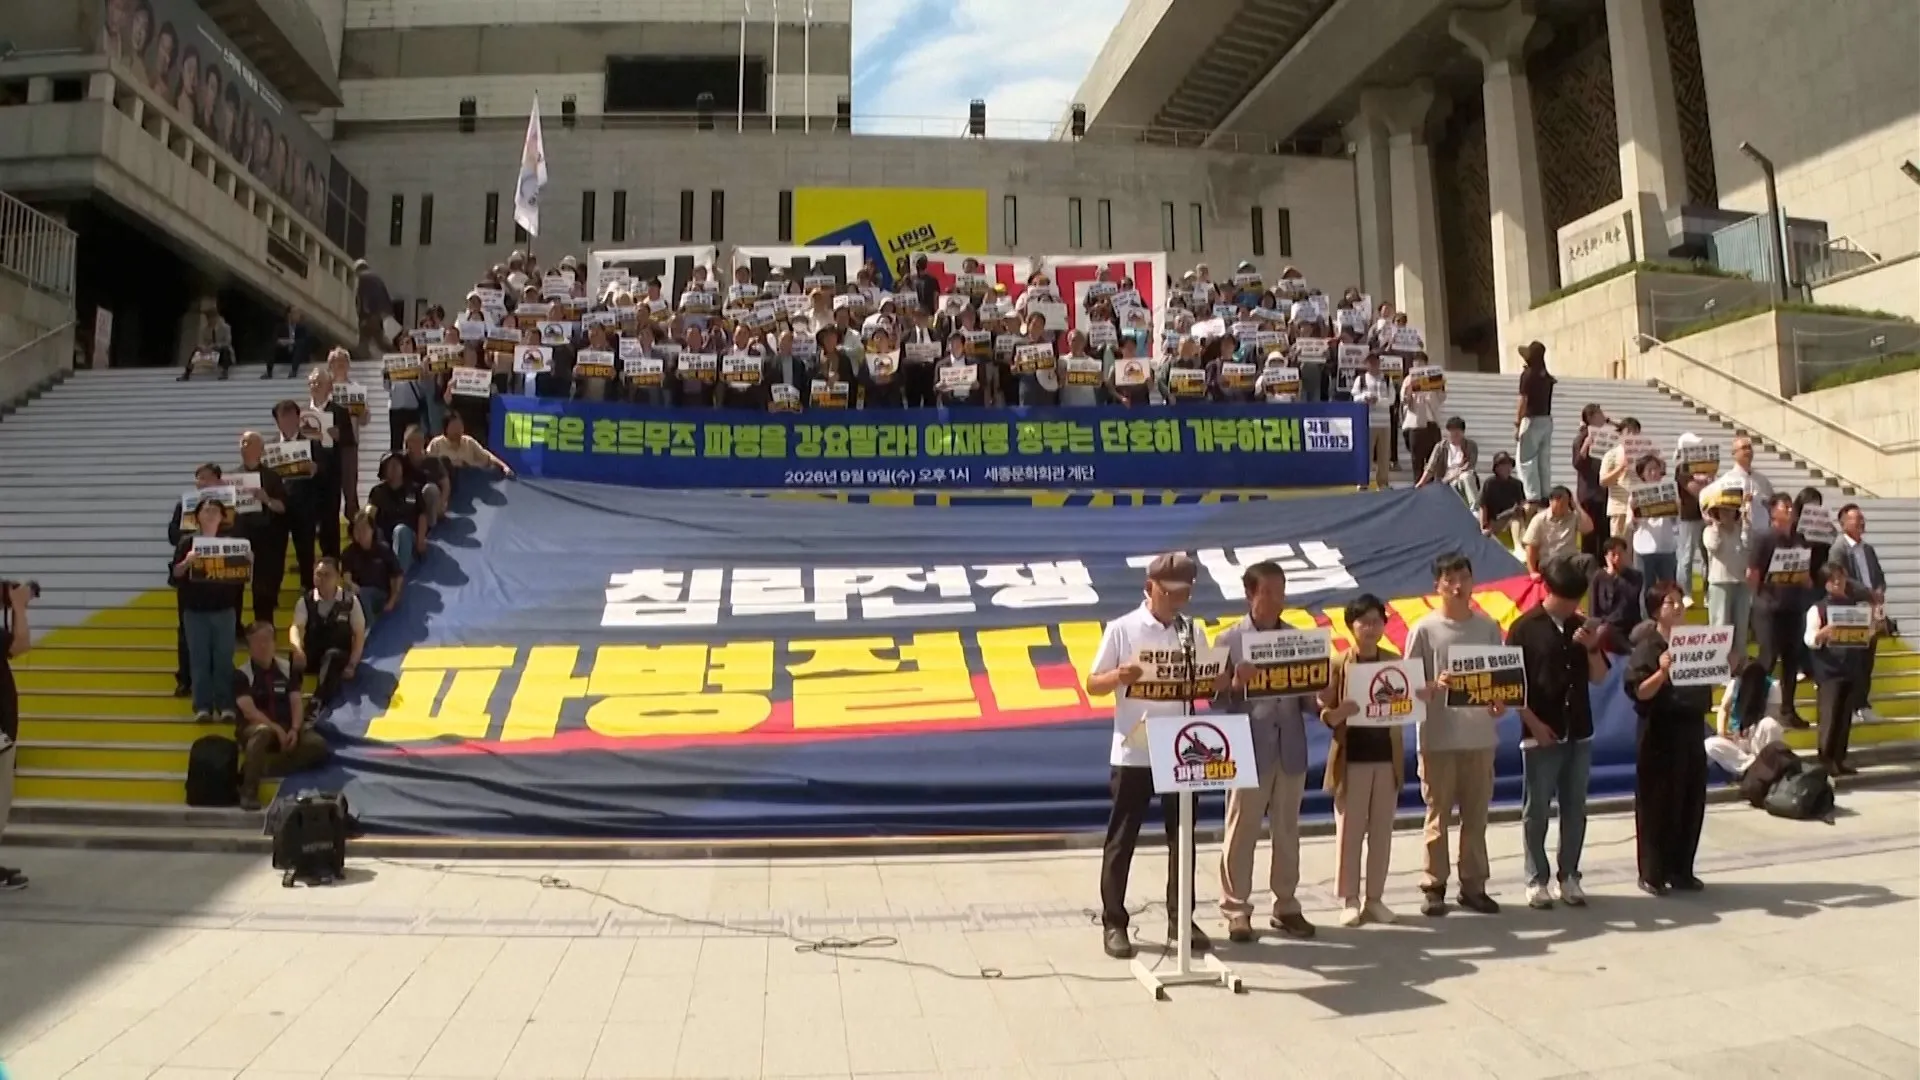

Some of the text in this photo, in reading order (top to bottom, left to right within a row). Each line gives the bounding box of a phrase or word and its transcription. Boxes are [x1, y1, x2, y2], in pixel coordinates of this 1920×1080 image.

[887, 223, 937, 253] 나만의
[504, 412, 1300, 458] 미국은 호르무즈 파병을 강요말라! 이재명 정부는 단호히 거부하라!
[1307, 421, 1329, 433] 각계
[1308, 435, 1349, 448] 기자회견
[785, 470, 837, 484] 2026년
[919, 468, 945, 482] 오후
[950, 467, 970, 483] 1시
[984, 466, 1065, 482] 세종문화회관
[1069, 465, 1095, 481] 계단
[600, 560, 1100, 627] 침략전쟁
[1672, 632, 1728, 647] DO NOT JOIN
[1452, 655, 1485, 672] 전쟁을
[1680, 651, 1703, 662] WAR
[1704, 649, 1717, 661] OF
